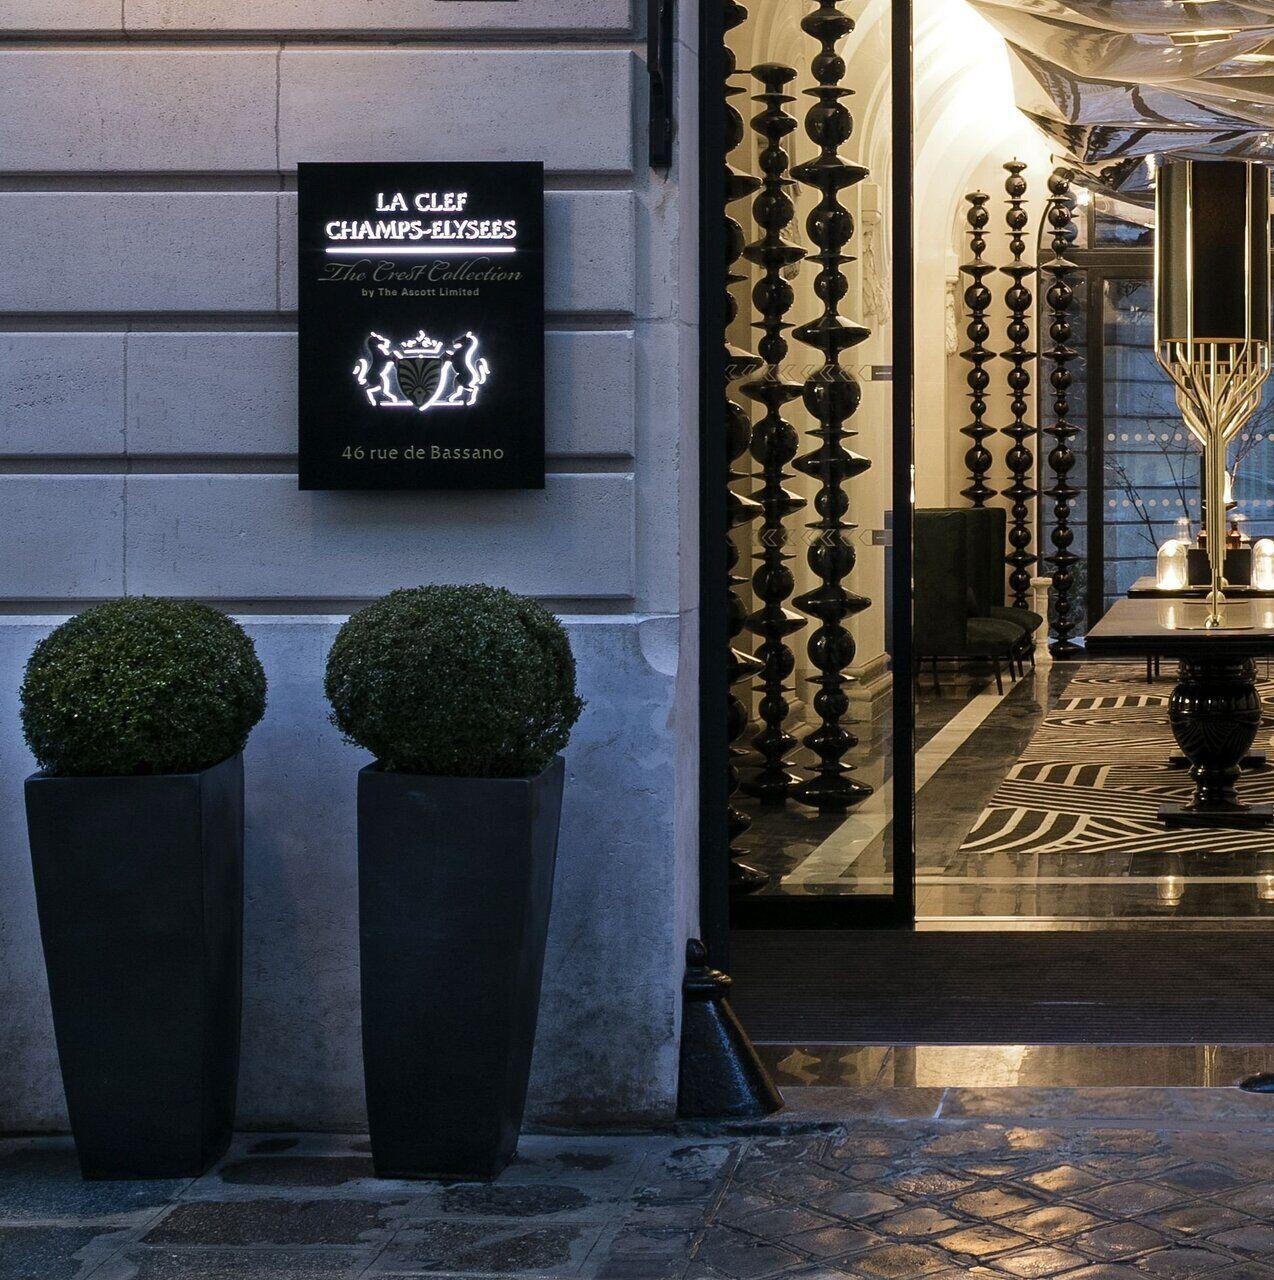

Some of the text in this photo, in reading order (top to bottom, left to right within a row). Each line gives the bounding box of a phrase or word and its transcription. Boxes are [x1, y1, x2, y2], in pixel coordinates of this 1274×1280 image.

[375, 192, 468, 212] LA CLEF
[324, 219, 518, 240] CHAMPS-ELYSEES
[318, 257, 524, 282] The Crest Collection
[361, 287, 480, 298] by The Ascott Limited
[342, 445, 504, 460] 46 rue de Bassano
